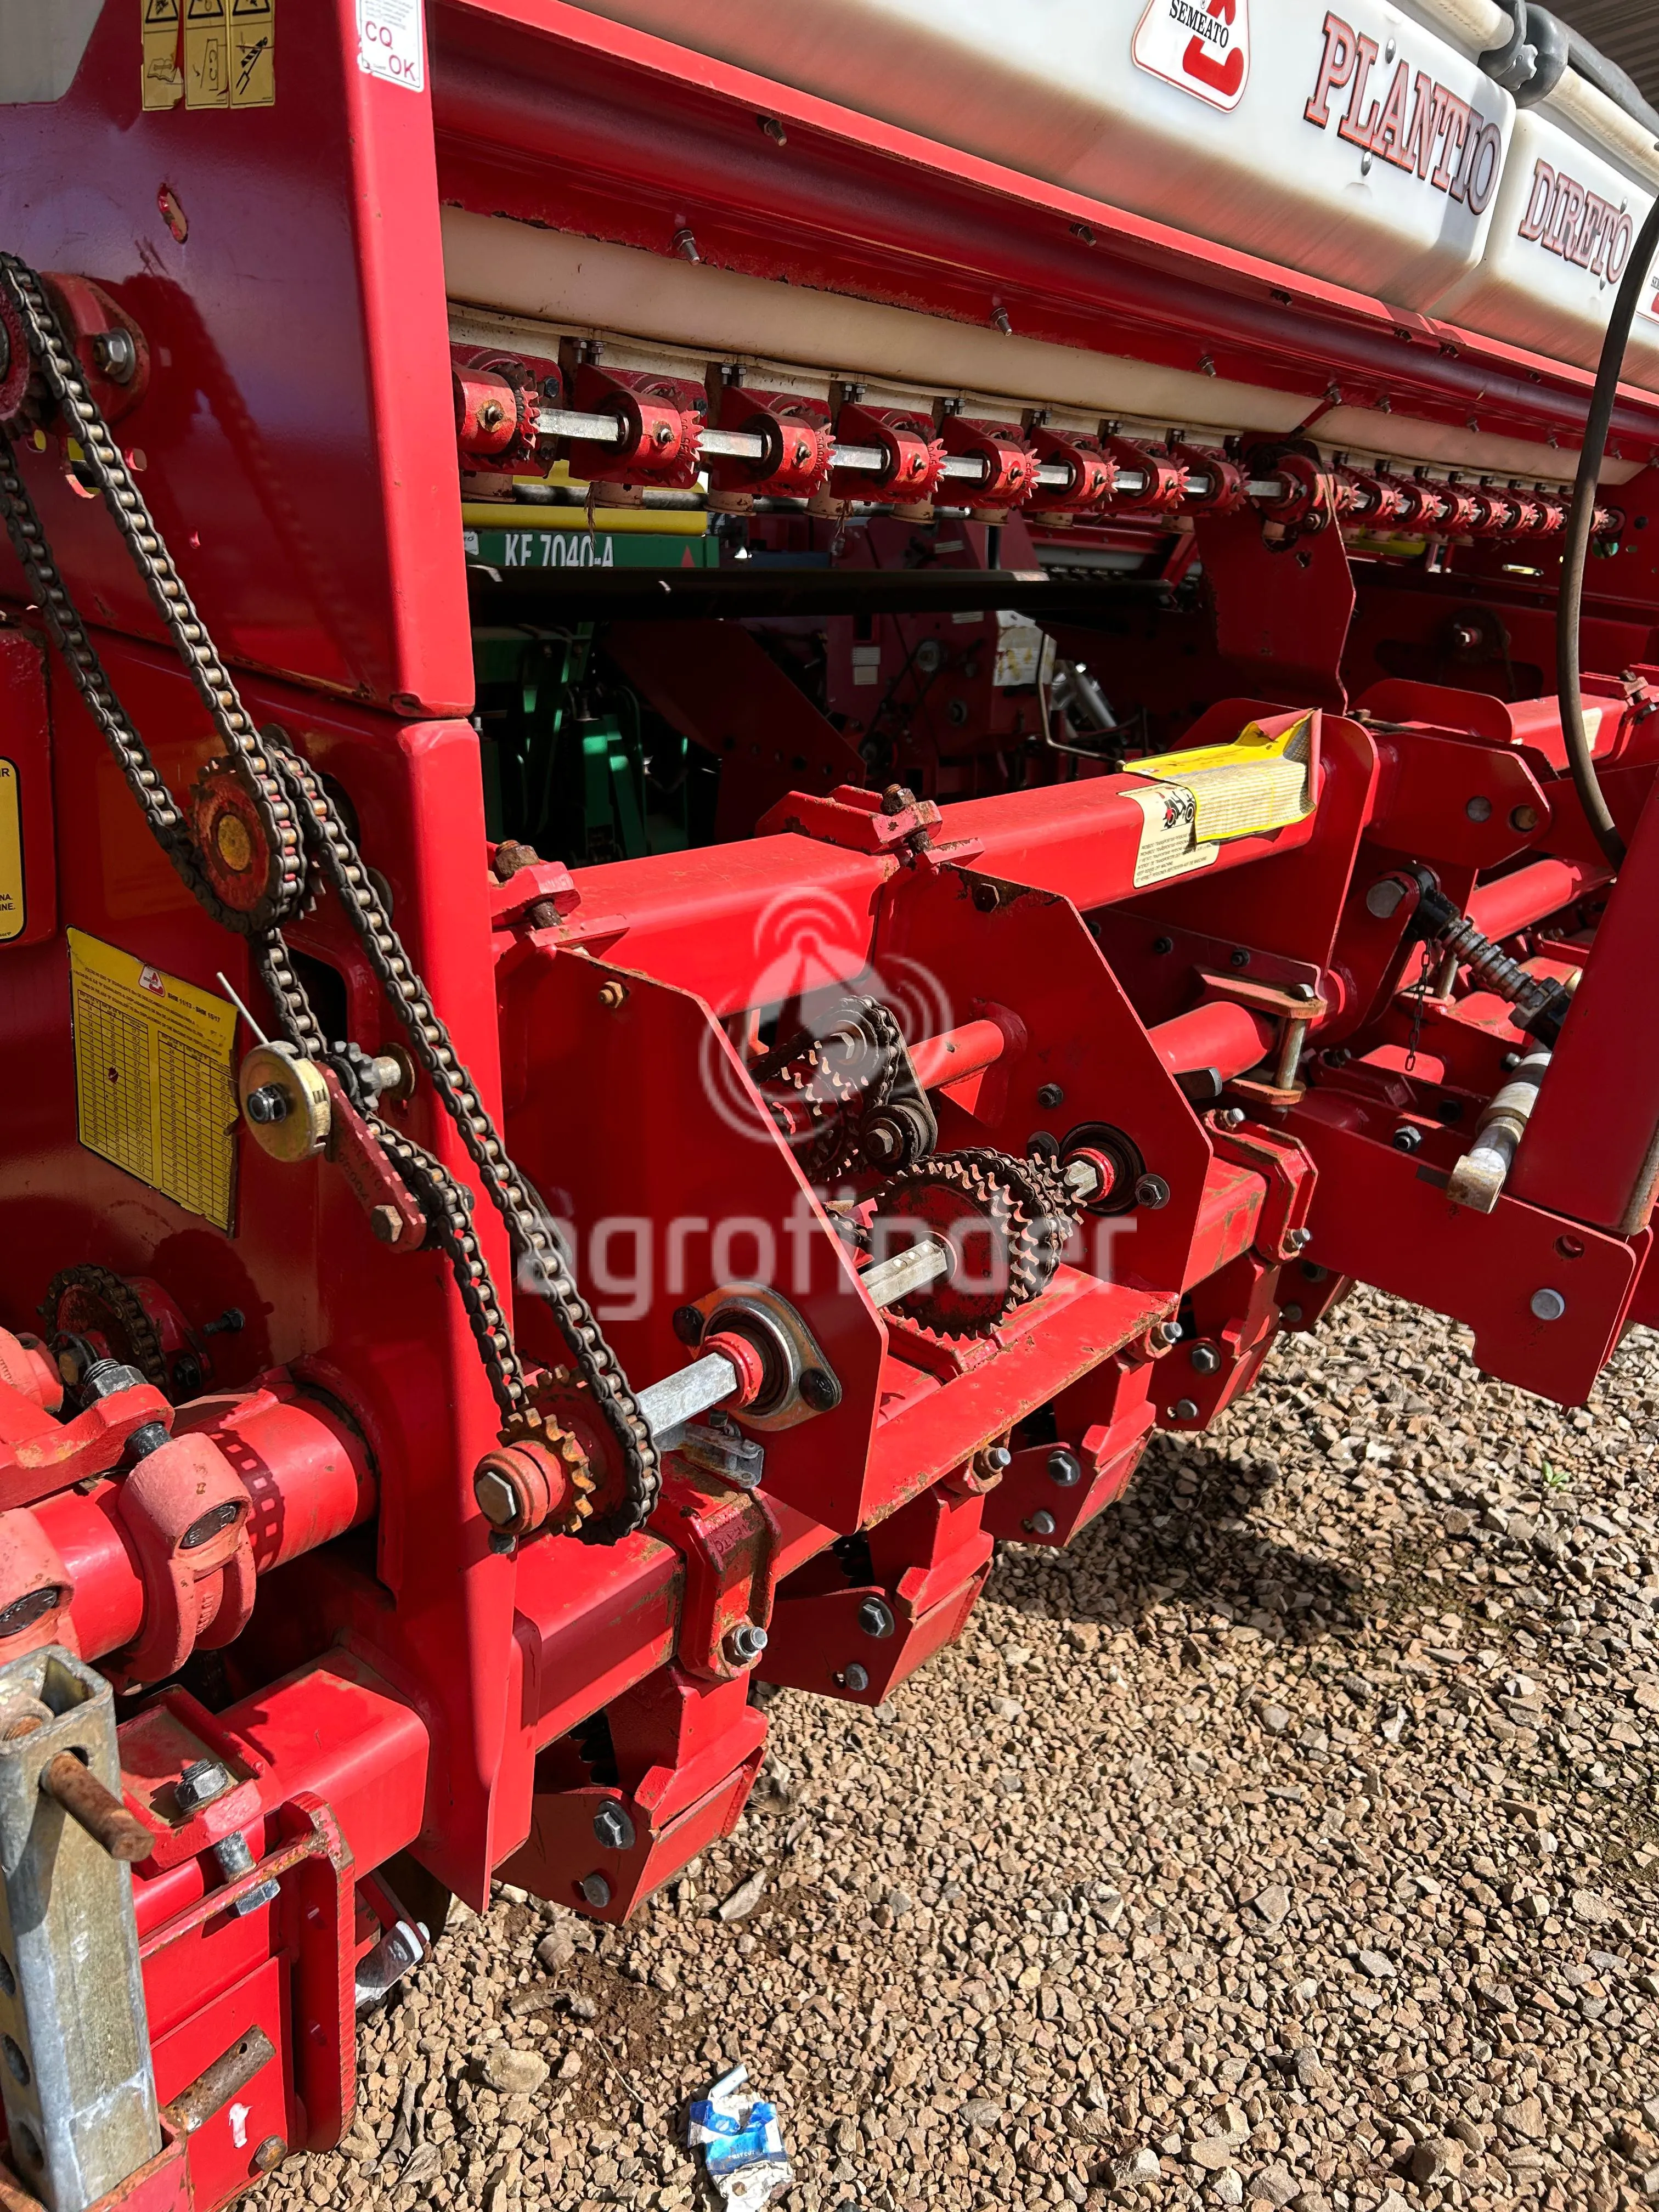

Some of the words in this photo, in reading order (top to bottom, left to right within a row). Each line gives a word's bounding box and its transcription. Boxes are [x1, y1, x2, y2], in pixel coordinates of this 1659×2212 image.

[365, 20, 393, 50] CQ
[1169, 0, 1229, 48] SEMEATO
[388, 54, 416, 81] OK
[1304, 10, 1502, 215] PLANTIO
[1517, 157, 1633, 284] DIRETO
[505, 534, 533, 567] KF
[540, 534, 614, 567] 7040-A
